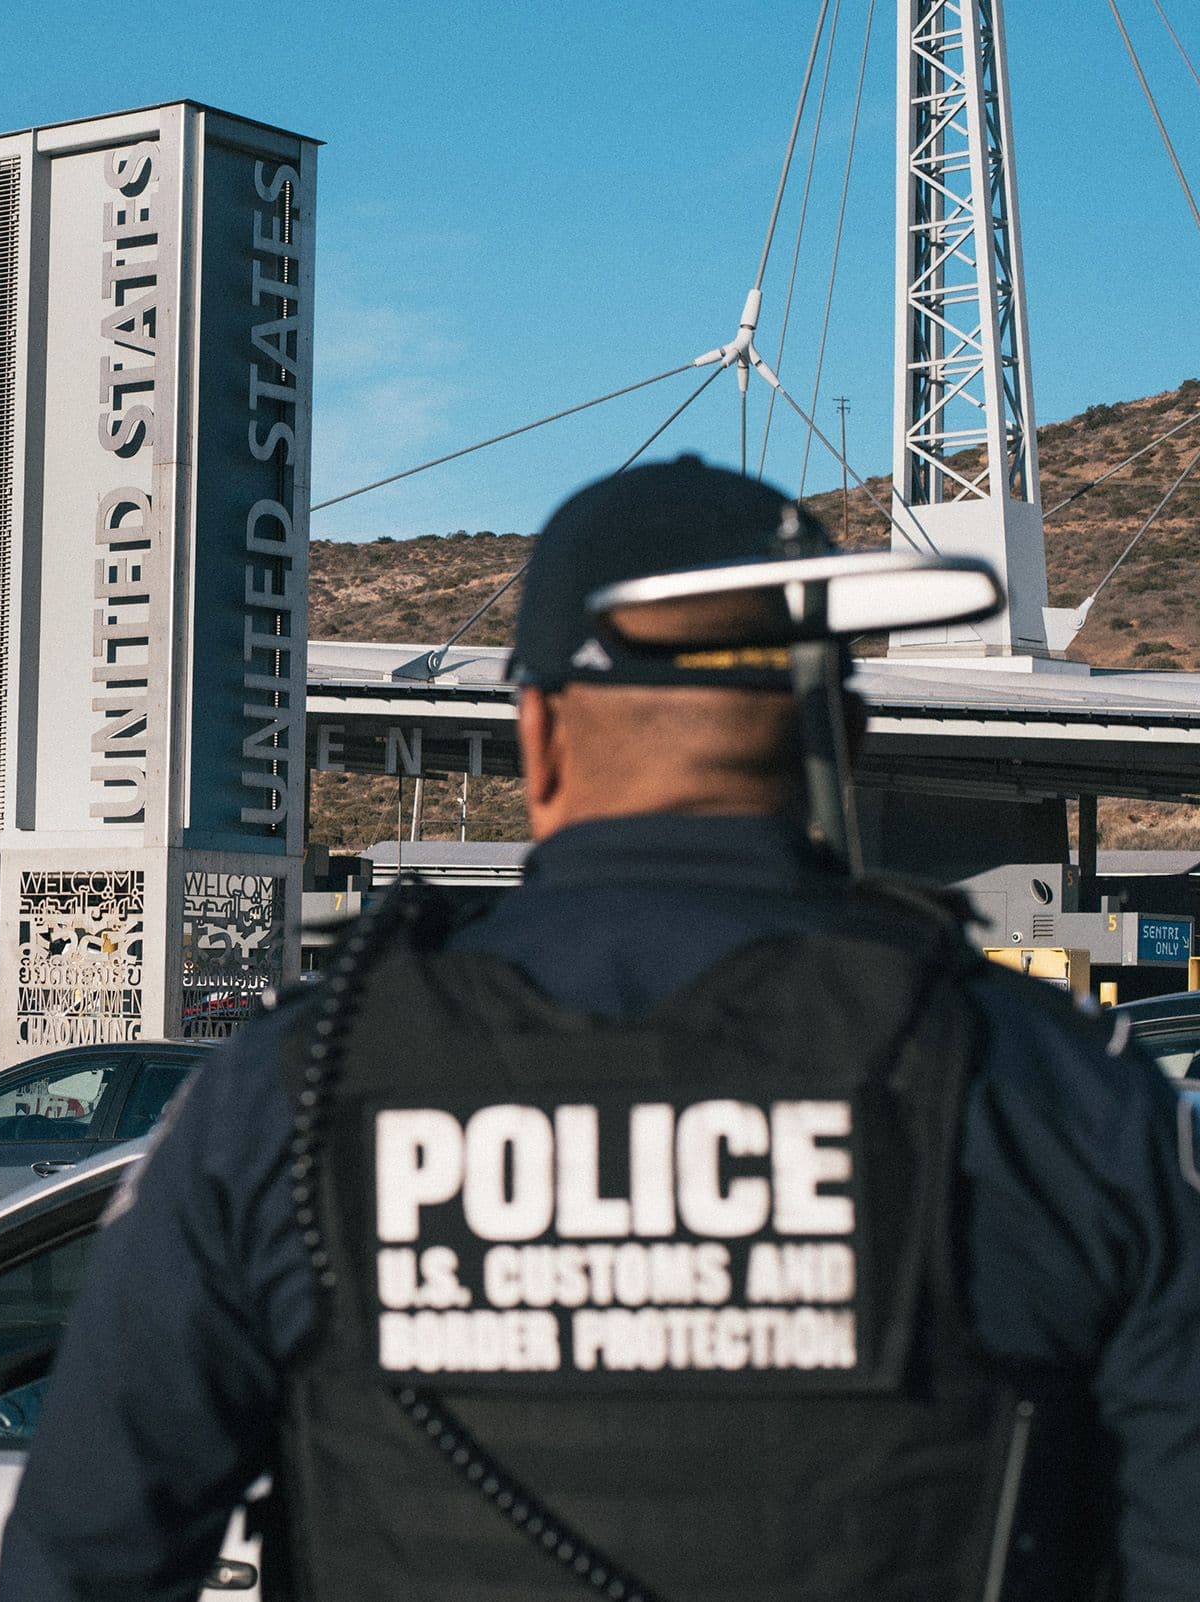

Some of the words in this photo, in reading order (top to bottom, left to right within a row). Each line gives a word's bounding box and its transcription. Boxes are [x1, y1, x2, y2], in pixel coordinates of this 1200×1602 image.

[98, 141, 160, 453] STATES
[248, 160, 301, 465] STATES
[89, 486, 152, 820] UNITED
[240, 499, 295, 824] UNITED
[316, 724, 493, 777] ENT
[335, 894, 343, 911] 7
[1108, 914, 1118, 931] 5
[1143, 925, 1179, 940] SENTRI
[1156, 942, 1179, 956] ONLY
[375, 1099, 855, 1242] POLICE
[377, 1246, 473, 1309] U.S.
[483, 1243, 731, 1308] CUSTOMS
[747, 1241, 856, 1303] AND
[572, 1306, 857, 1372] PROTECTION
